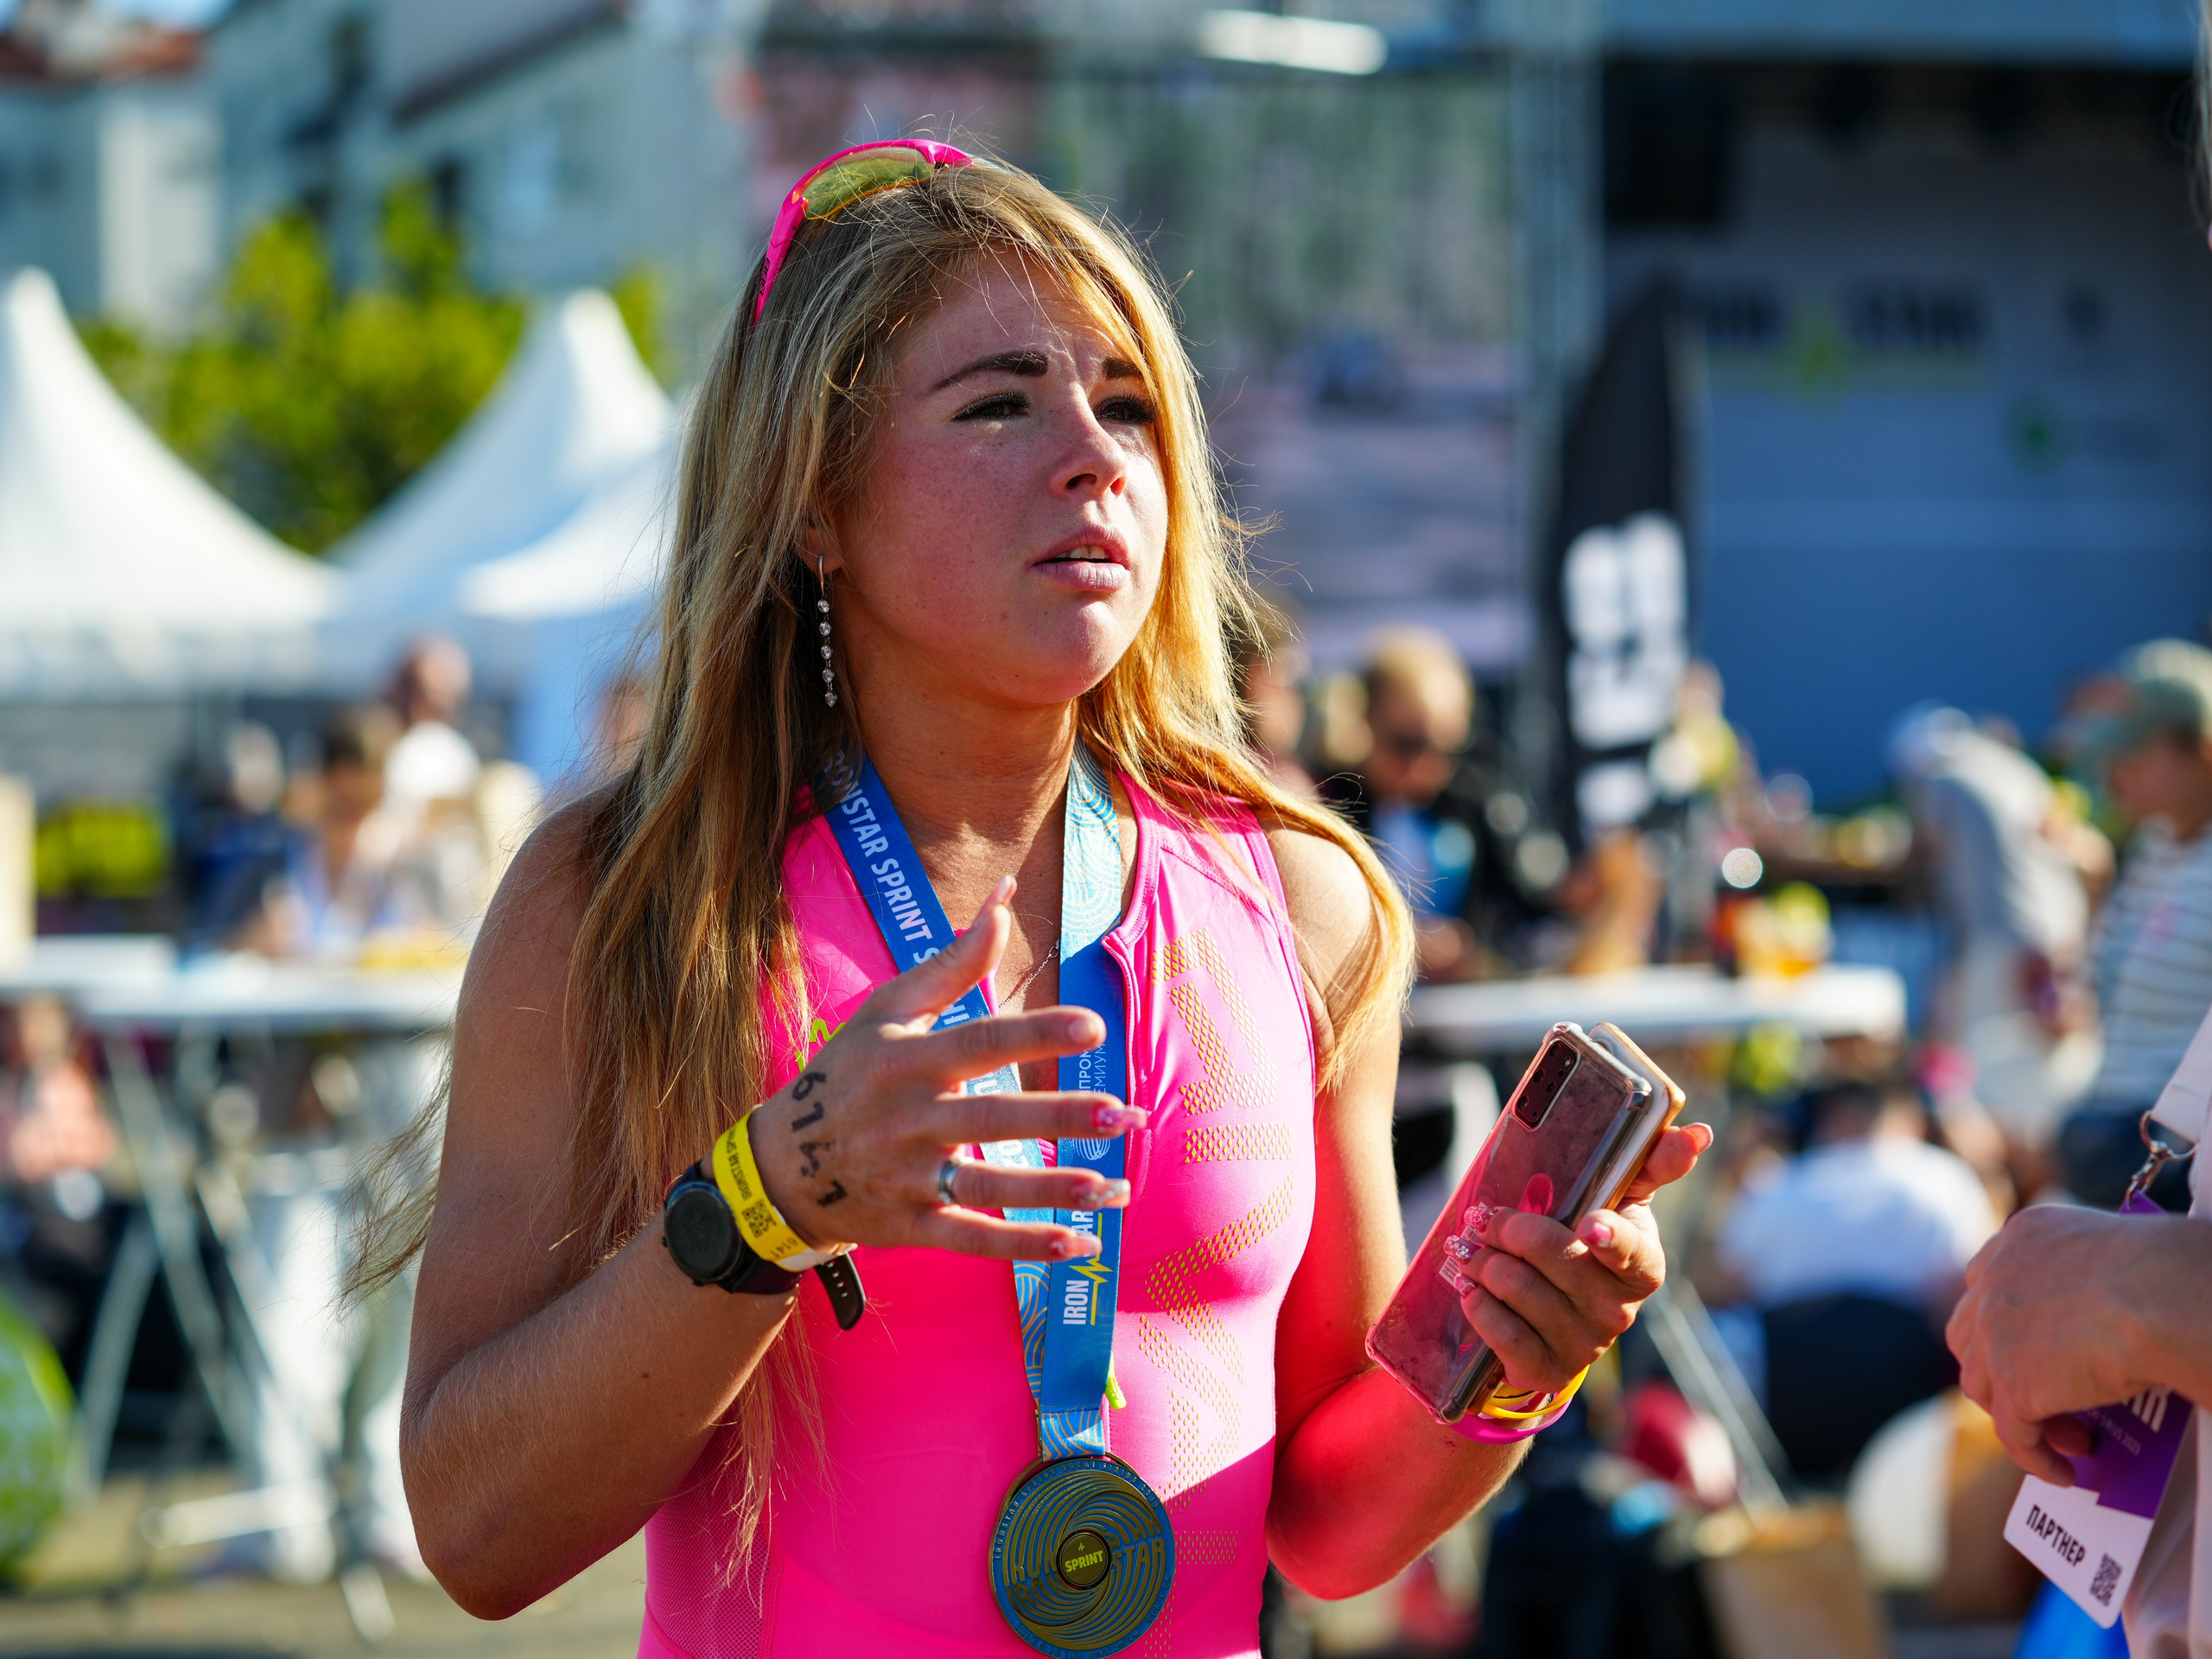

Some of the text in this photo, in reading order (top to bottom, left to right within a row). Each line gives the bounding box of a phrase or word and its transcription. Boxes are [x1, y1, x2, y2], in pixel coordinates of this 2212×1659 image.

[823, 749, 888, 857] RONSTAR
[871, 858, 933, 942] SPRINT
[913, 947, 969, 1026] SHI
[1078, 1047, 1091, 1096] ЗПРОМ
[1094, 1044, 1106, 1095] ЕМИУМ
[769, 1236, 799, 1259] 6141
[1062, 1280, 1090, 1325] IRON
[995, 1501, 1020, 1560] IRONSTAR
[1062, 1460, 1096, 1471] SOCHI
[1102, 1463, 1138, 1484] SIRIUS
[2025, 1503, 2087, 1567] ПАРТНЕР
[1064, 1549, 1104, 1573] SPRINT
